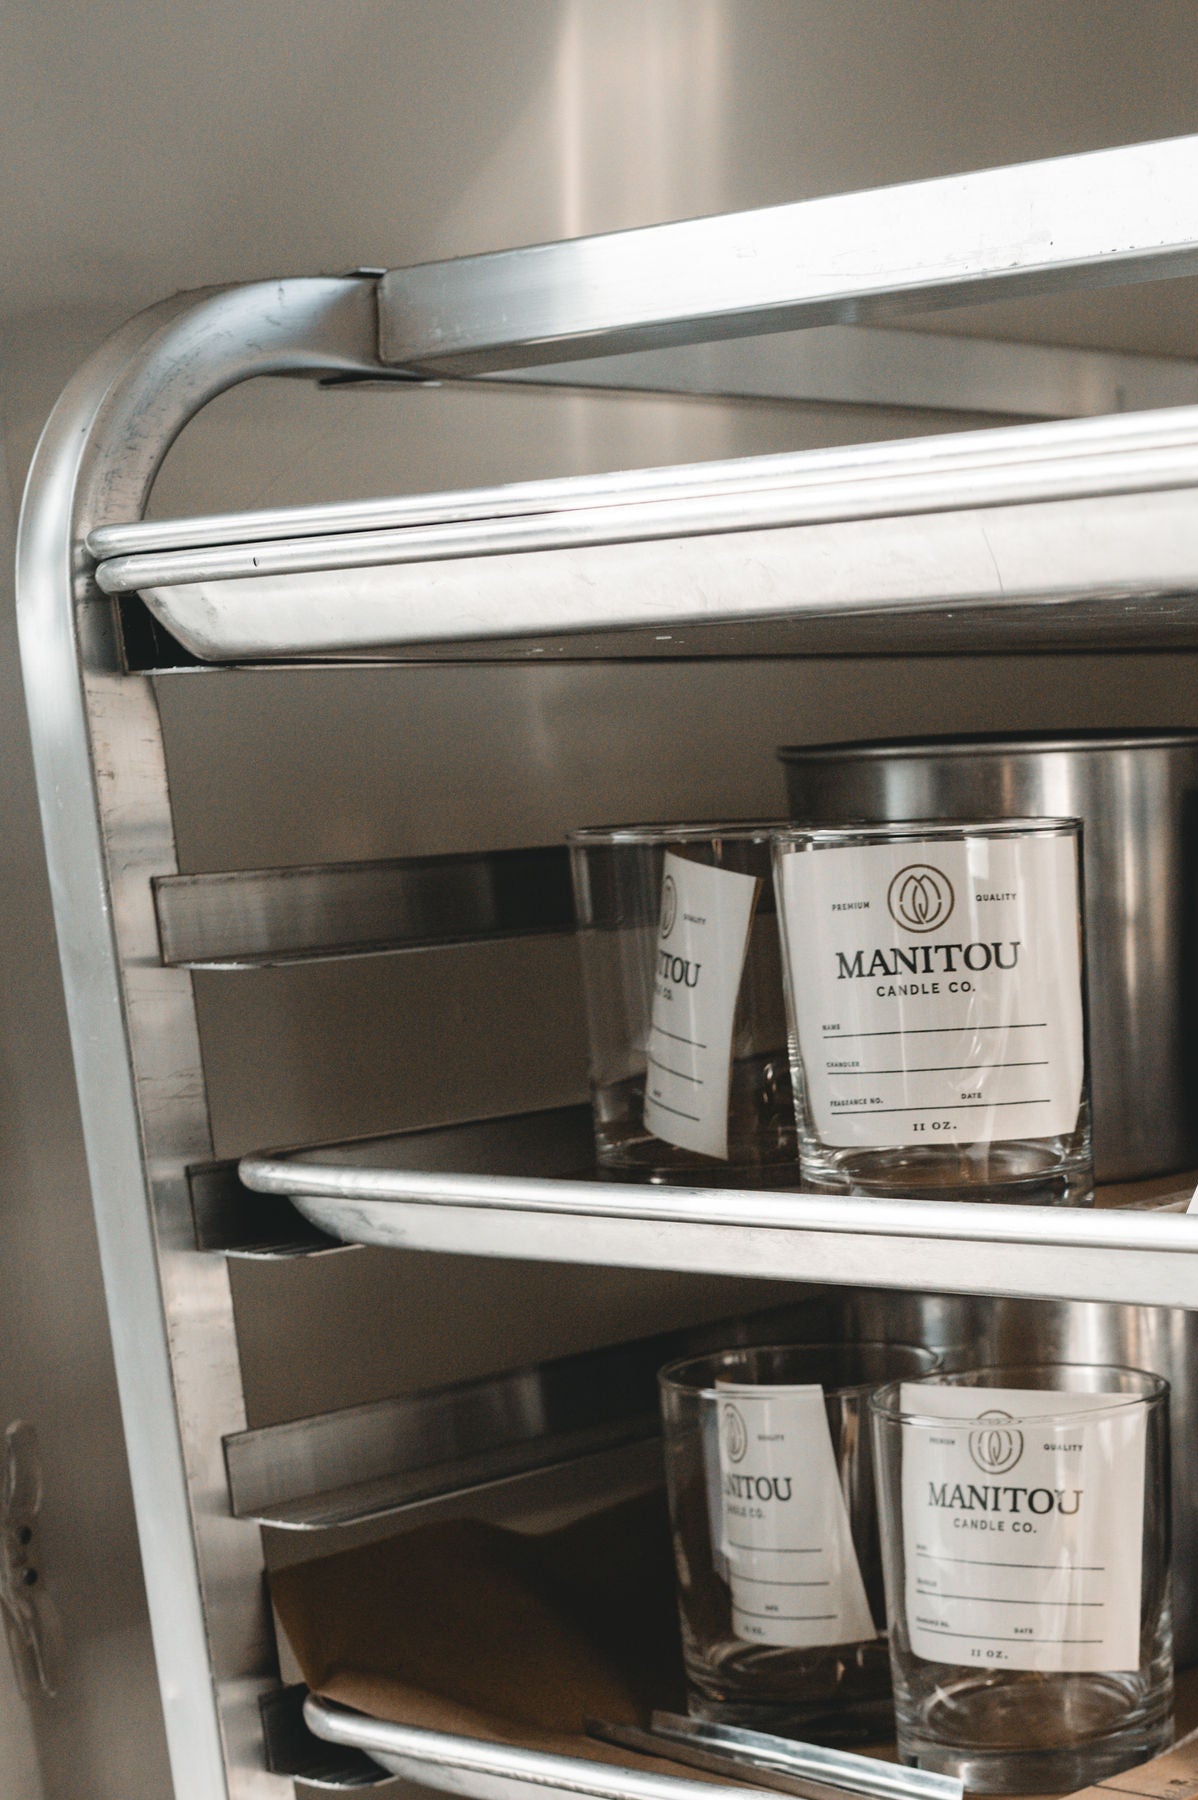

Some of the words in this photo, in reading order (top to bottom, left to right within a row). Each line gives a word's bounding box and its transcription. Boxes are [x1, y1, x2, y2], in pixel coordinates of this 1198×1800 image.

[975, 892, 1017, 902] QUALITY
[836, 941, 1021, 979] MANITOU
[876, 983, 940, 997] CANDLE
[949, 981, 976, 993] CO.
[961, 1092, 982, 1100] DATE
[932, 1121, 957, 1131] OZ.
[928, 1481, 1083, 1516] MANITOU
[953, 1518, 1005, 1532] CANDLE
[1011, 1521, 1038, 1534] CO.
